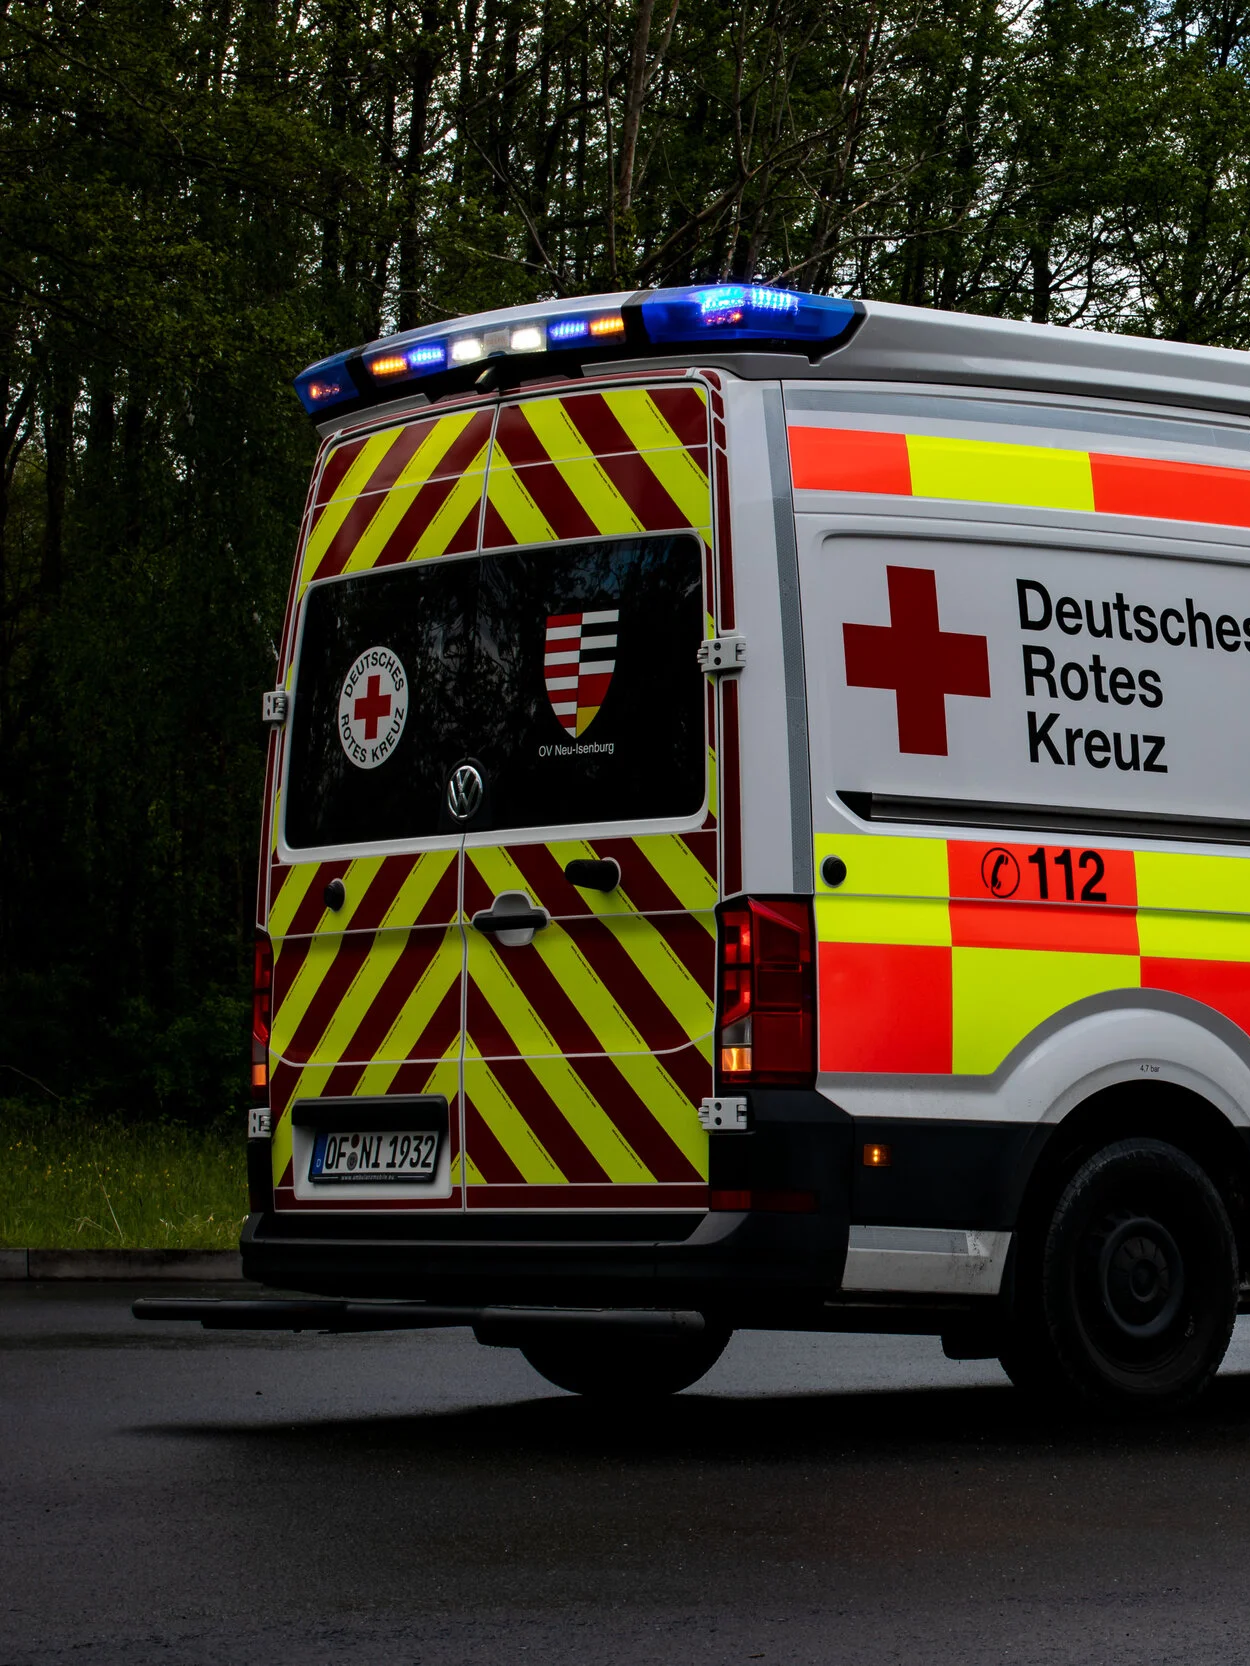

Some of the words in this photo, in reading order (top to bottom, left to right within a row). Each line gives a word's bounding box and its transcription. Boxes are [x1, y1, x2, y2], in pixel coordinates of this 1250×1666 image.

[344, 651, 404, 698] DEUTSCHES
[1022, 644, 1164, 709] Rotes
[341, 713, 367, 763] ROTES
[371, 707, 405, 763] KREUZ
[538, 745, 553, 757] OV
[554, 741, 614, 755] Neu-Isenburg
[1026, 711, 1169, 773] Kreuz
[448, 765, 483, 818] VW
[1028, 847, 1107, 902] 112
[1150, 1065, 1160, 1073] bar
[325, 1136, 349, 1169] OF
[358, 1135, 383, 1168] NI
[386, 1135, 436, 1168] 1932
